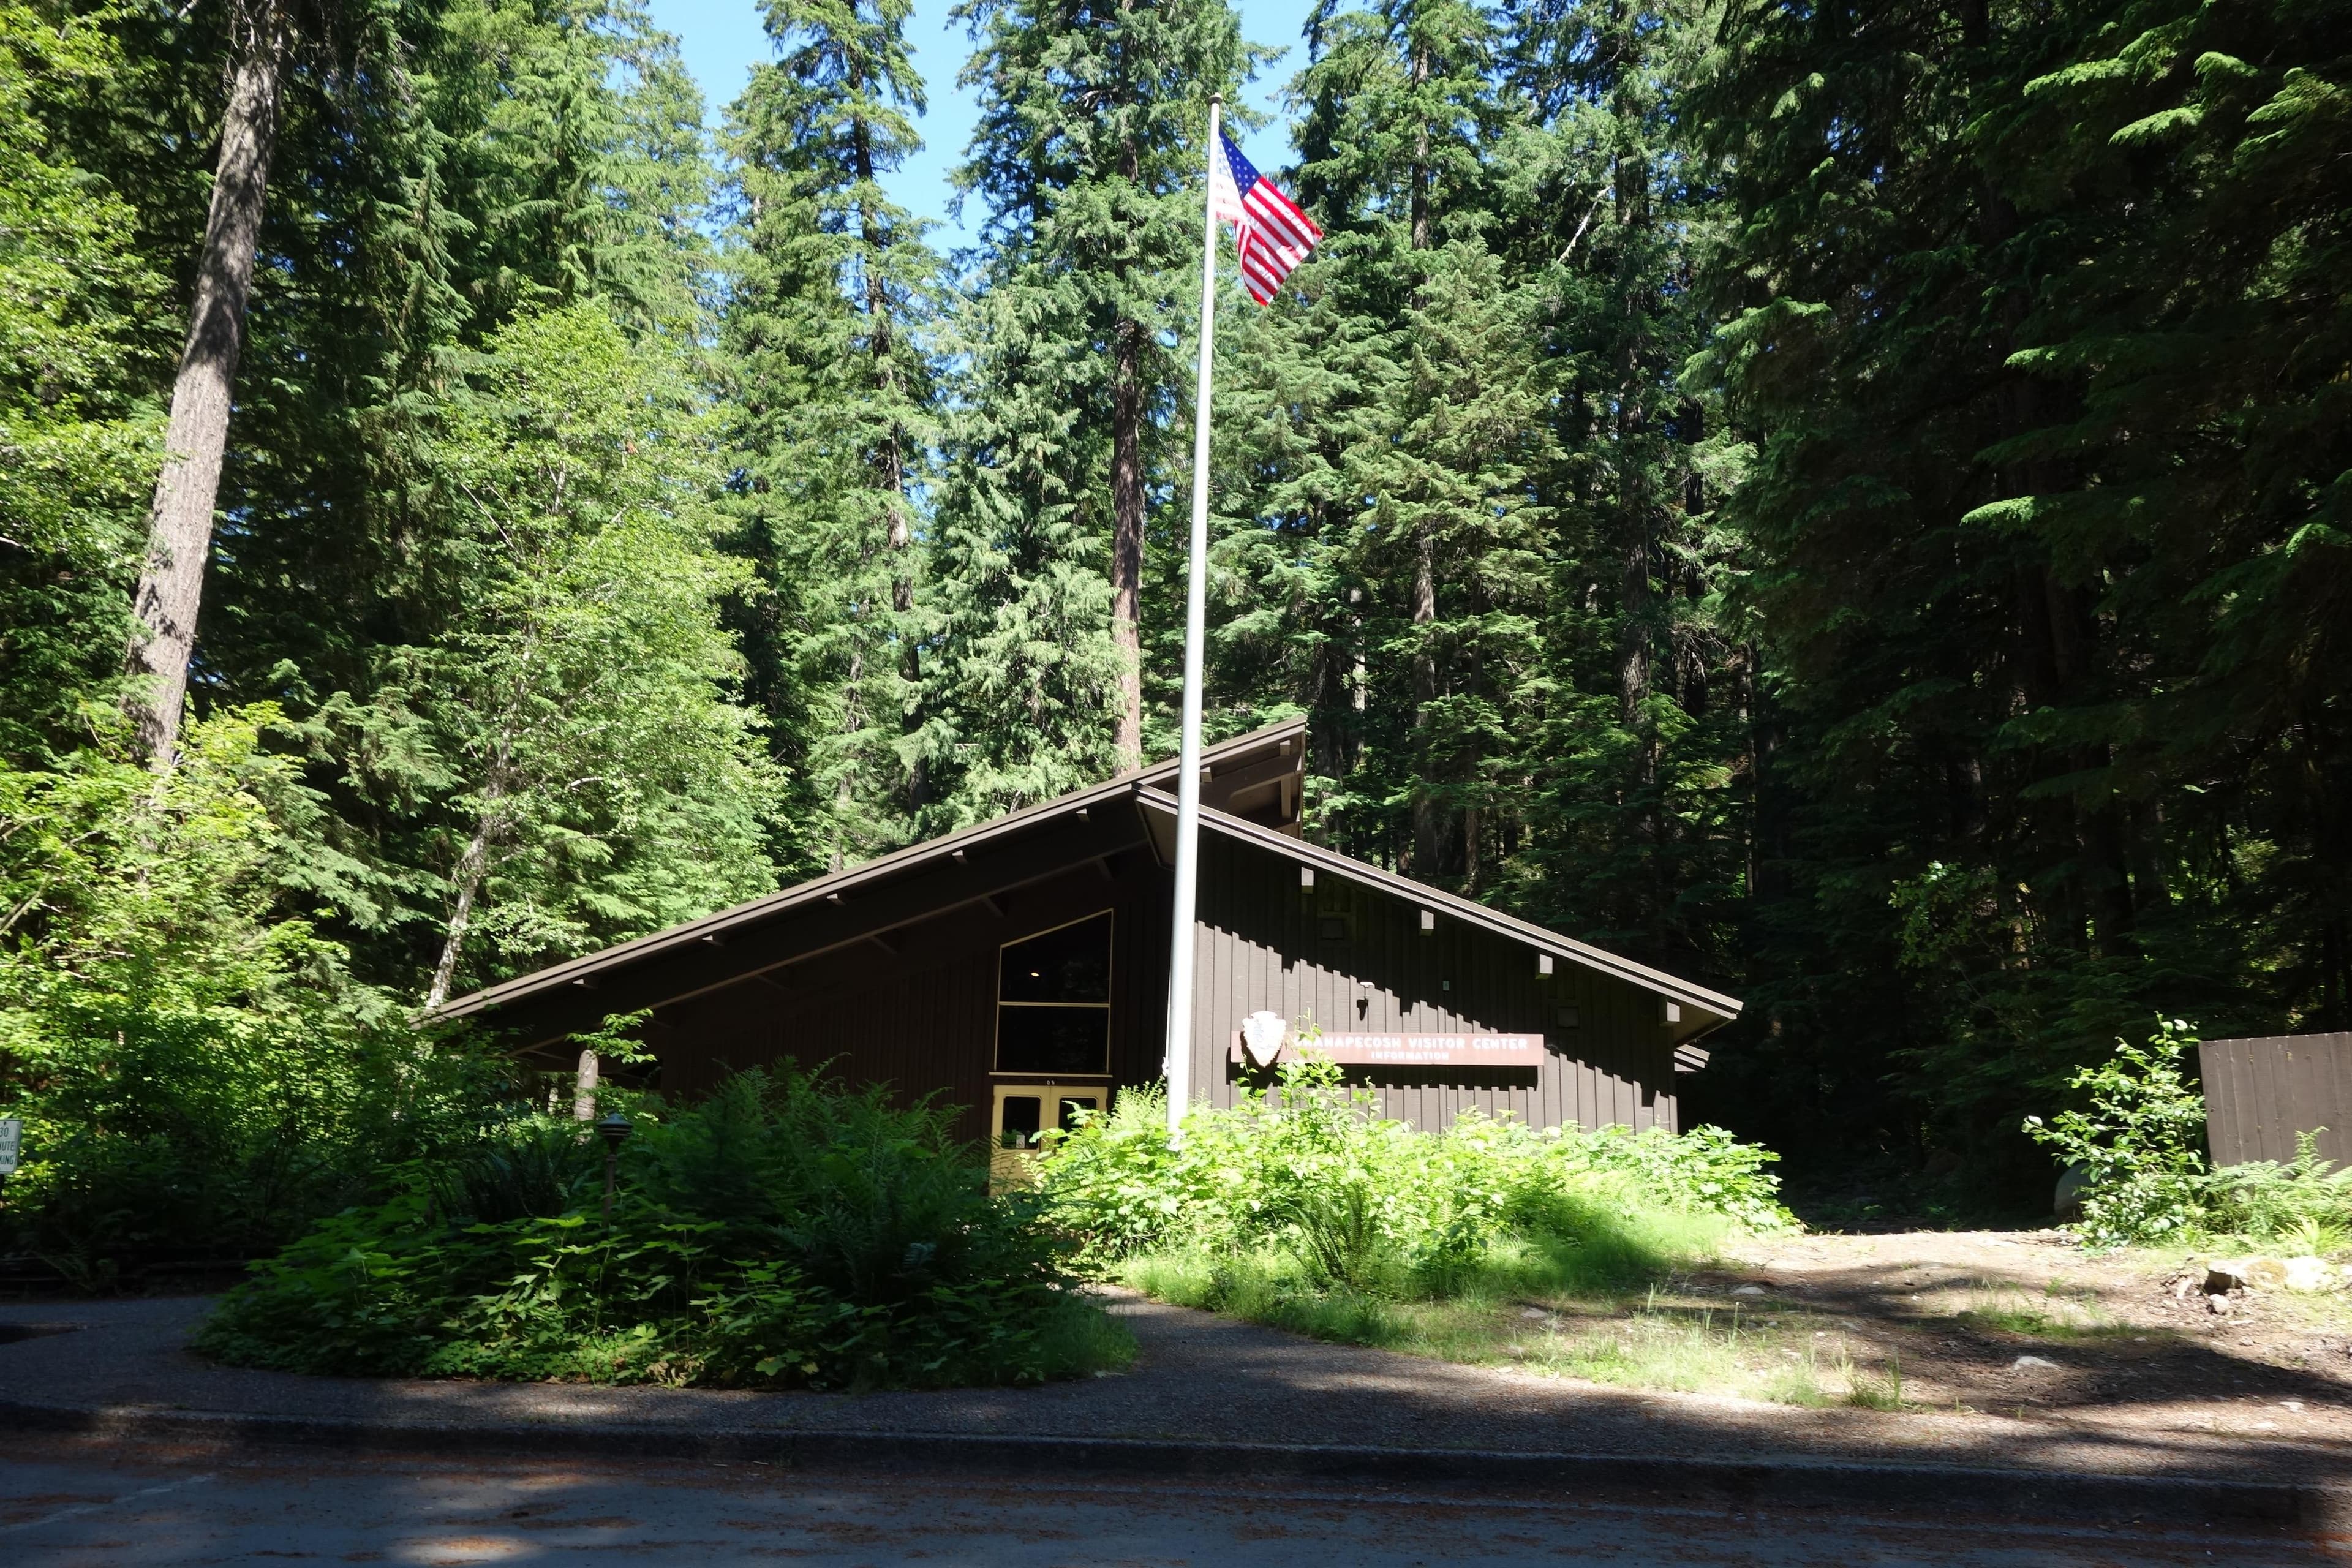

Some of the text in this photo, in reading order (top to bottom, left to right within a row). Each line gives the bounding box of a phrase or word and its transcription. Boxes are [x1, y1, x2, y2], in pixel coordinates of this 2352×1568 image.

[1408, 1037, 1466, 1049] VISITOR
[1472, 1038, 1528, 1049] CENTER
[1371, 1051, 1449, 1060] INFORMATION
[0, 1127, 9, 1137] 30
